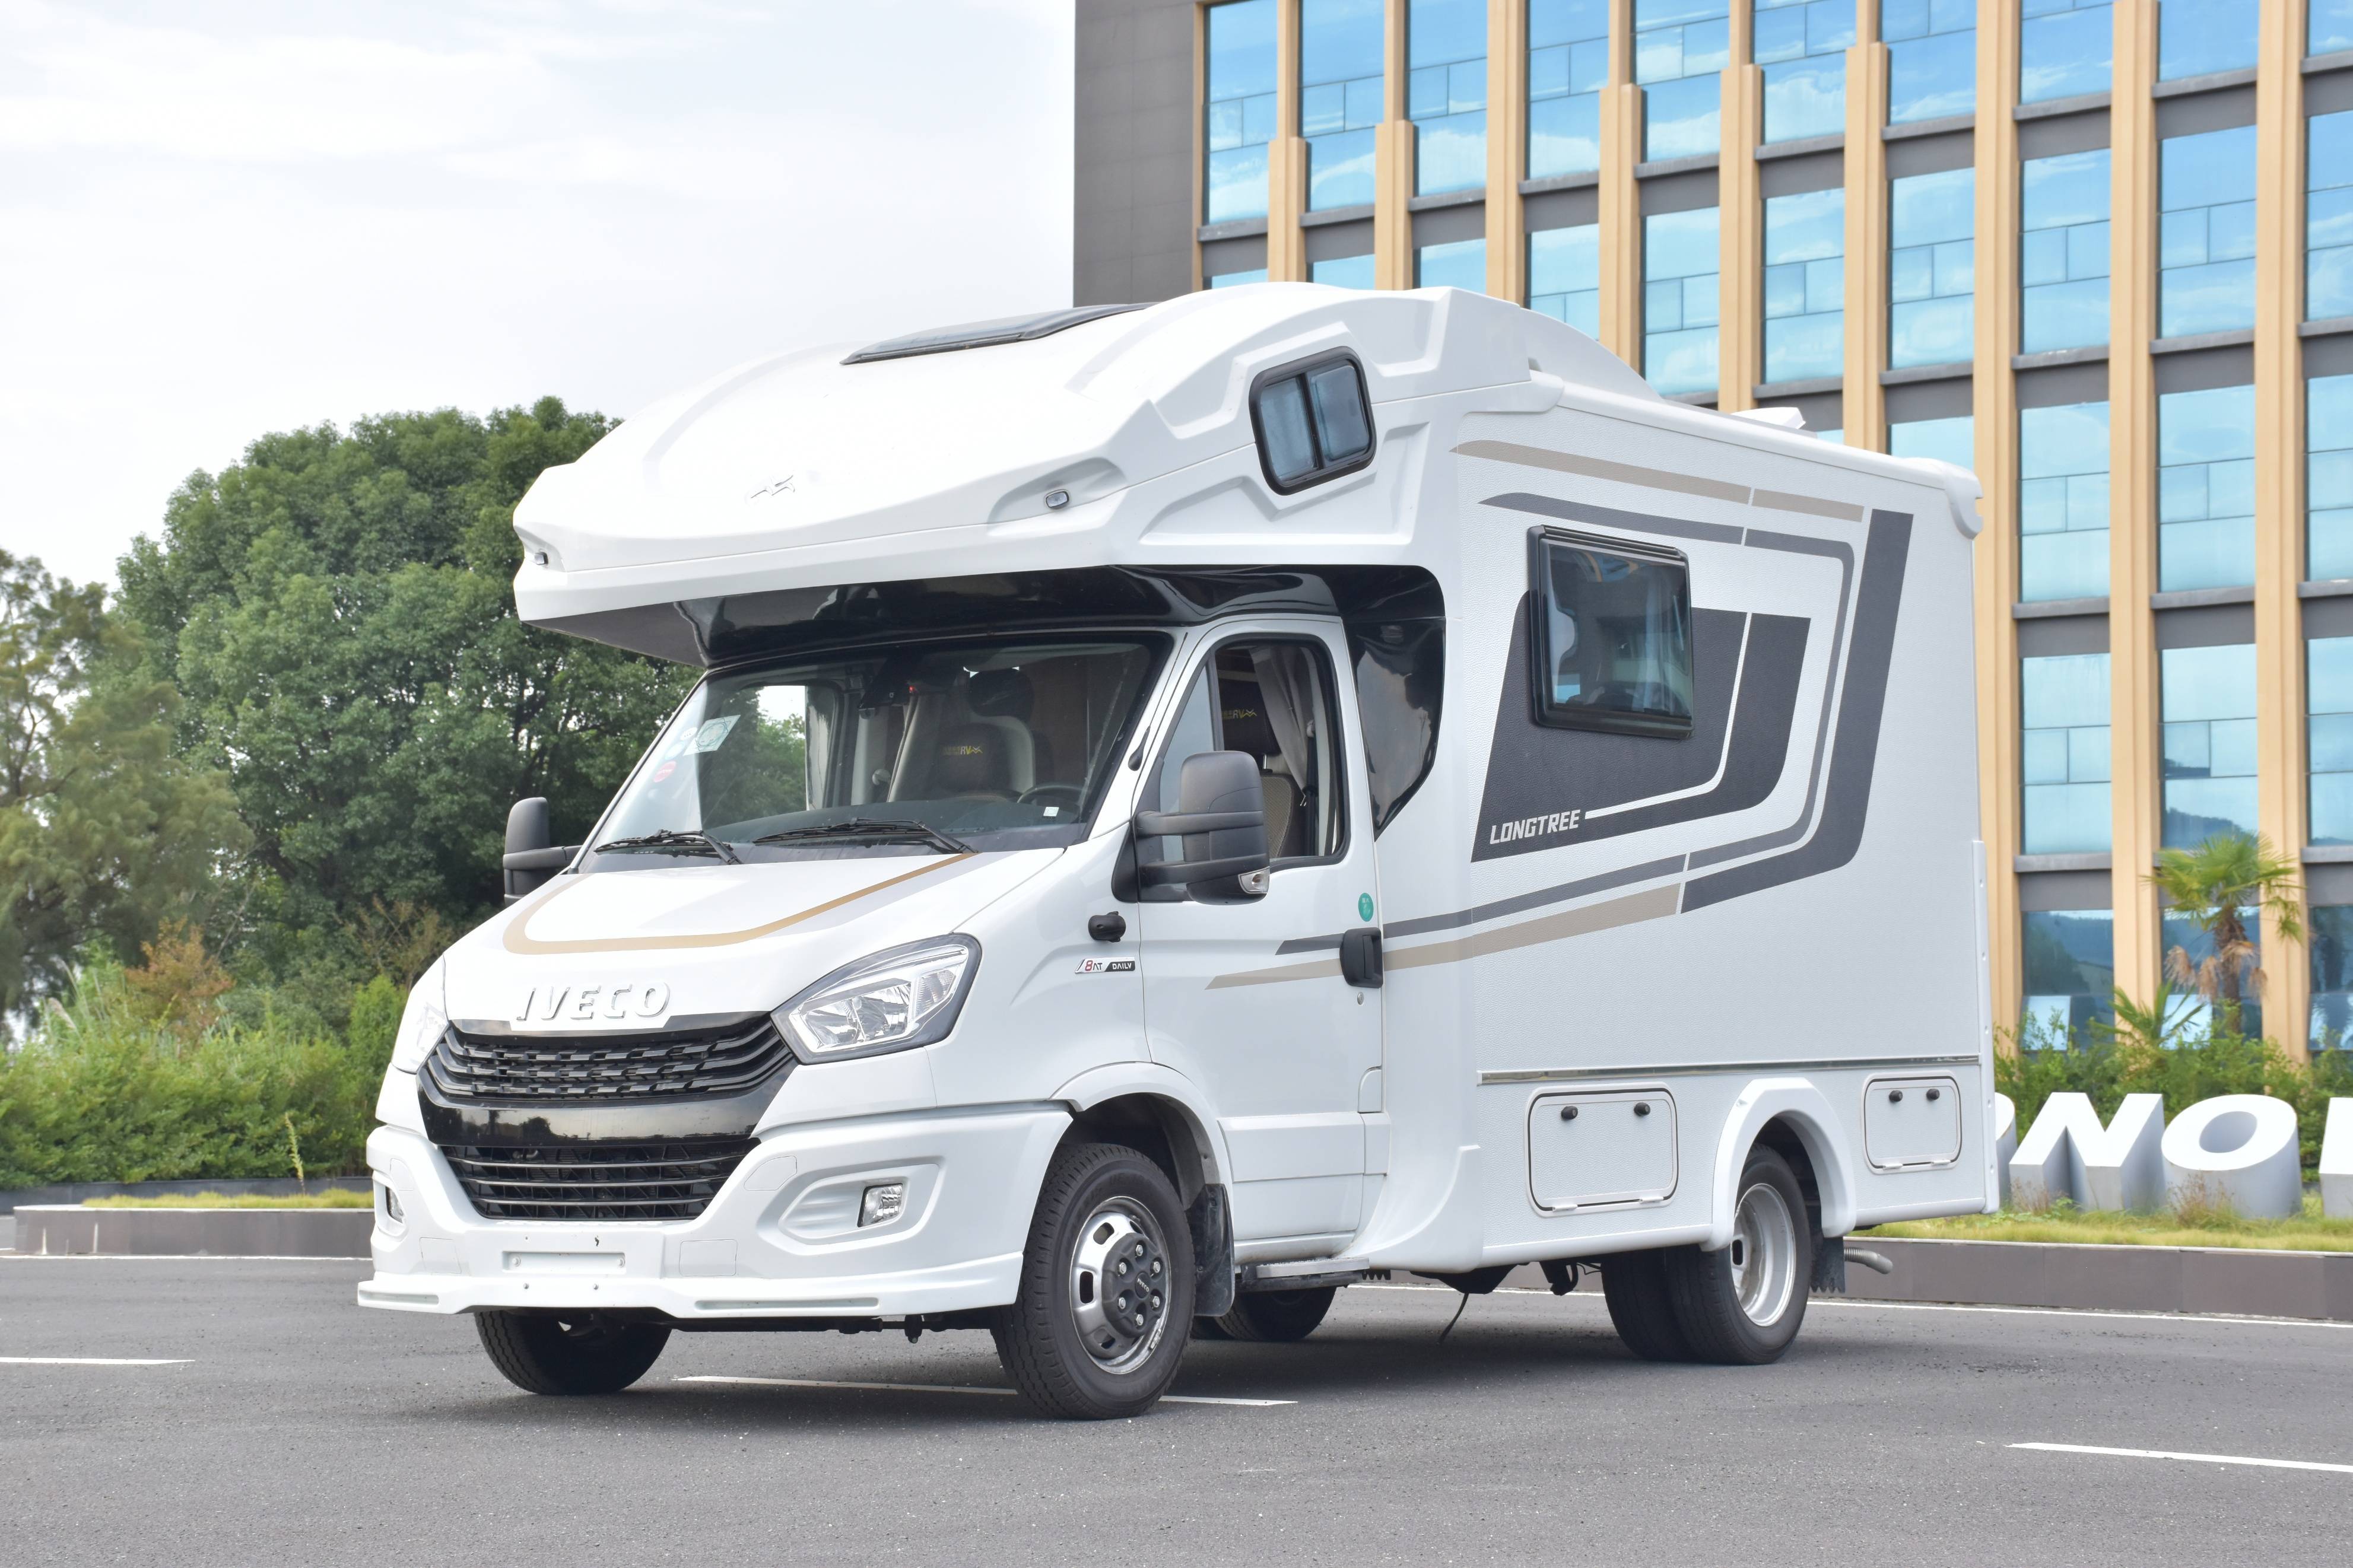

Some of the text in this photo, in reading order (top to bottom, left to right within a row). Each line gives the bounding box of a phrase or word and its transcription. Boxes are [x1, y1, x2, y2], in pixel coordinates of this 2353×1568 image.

[1490, 809, 1580, 844] LONGTREE
[515, 981, 670, 1021] IVECO
[1137, 1278, 1149, 1292] IVECO
